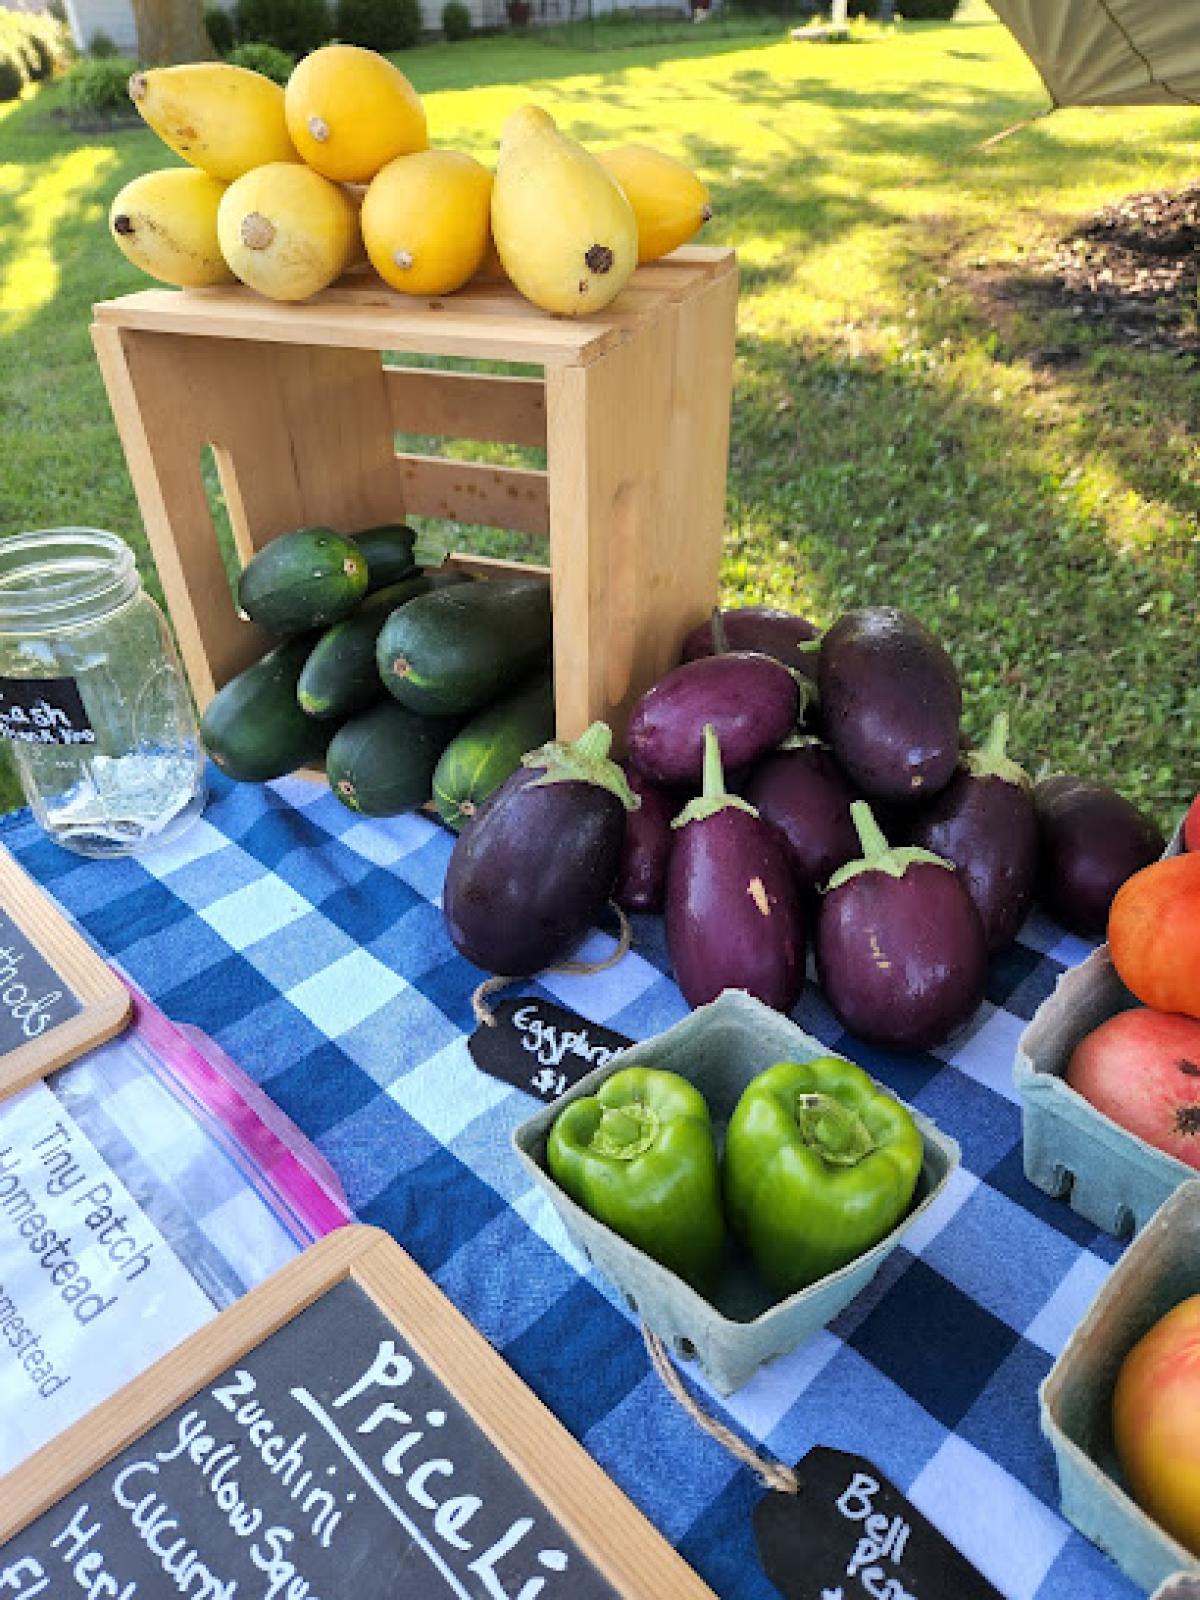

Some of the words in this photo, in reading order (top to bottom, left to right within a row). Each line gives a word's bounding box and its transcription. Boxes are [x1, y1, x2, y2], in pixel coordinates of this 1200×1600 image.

[31, 1121, 87, 1197] Tiny
[70, 1181, 153, 1282] Patch
[0, 1284, 71, 1398] mestead
[331, 1340, 483, 1551] Price
[834, 1472, 912, 1566] Bell
